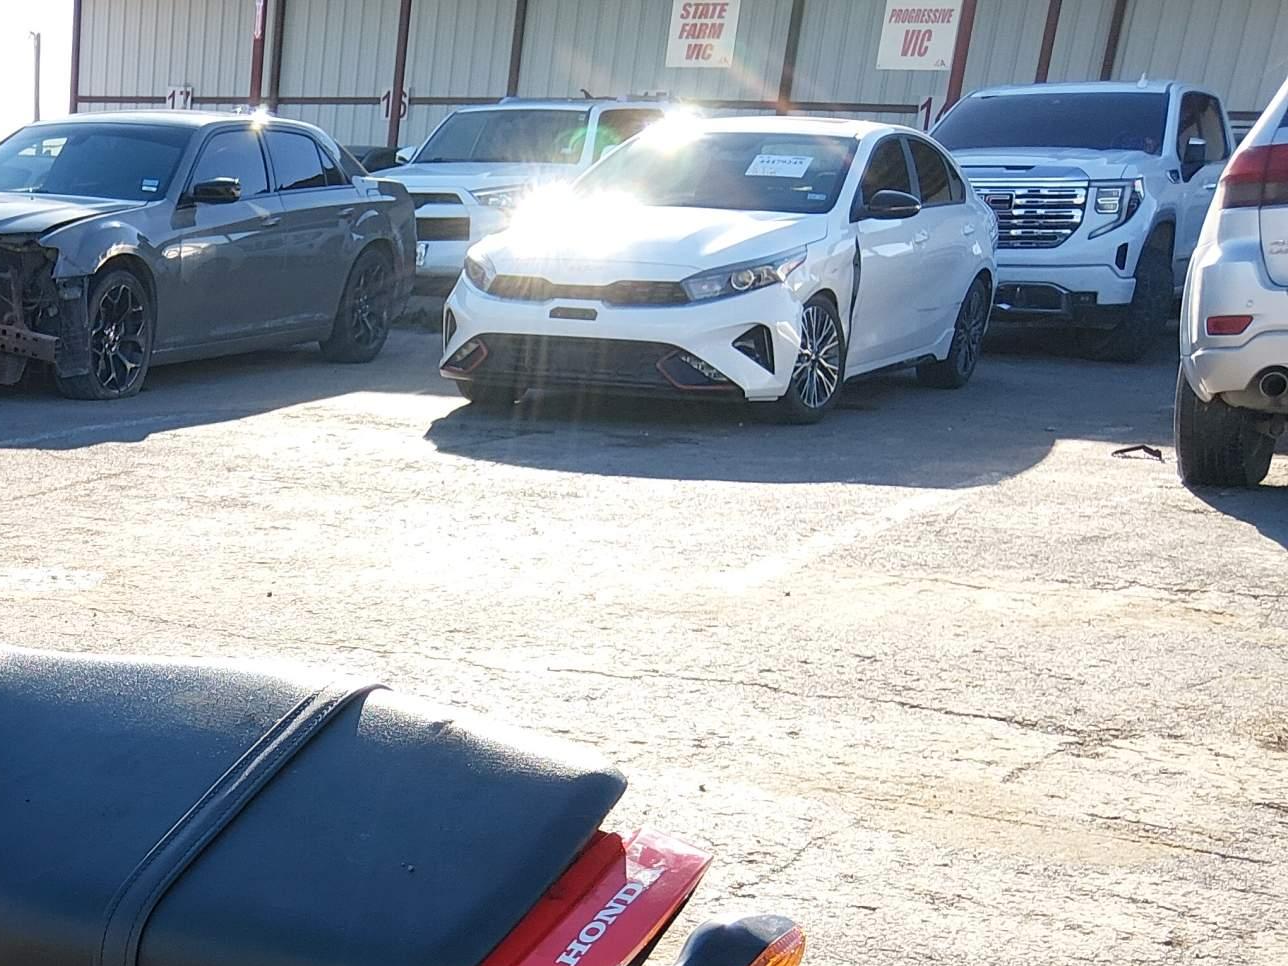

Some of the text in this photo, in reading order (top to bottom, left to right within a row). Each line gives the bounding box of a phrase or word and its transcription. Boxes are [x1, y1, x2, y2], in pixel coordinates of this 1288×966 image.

[680, 2, 729, 20] STATE
[888, 8, 955, 24] PROGRESSIVE
[678, 22, 725, 40] FARM
[900, 28, 933, 57] VIC
[685, 43, 713, 61] VIC
